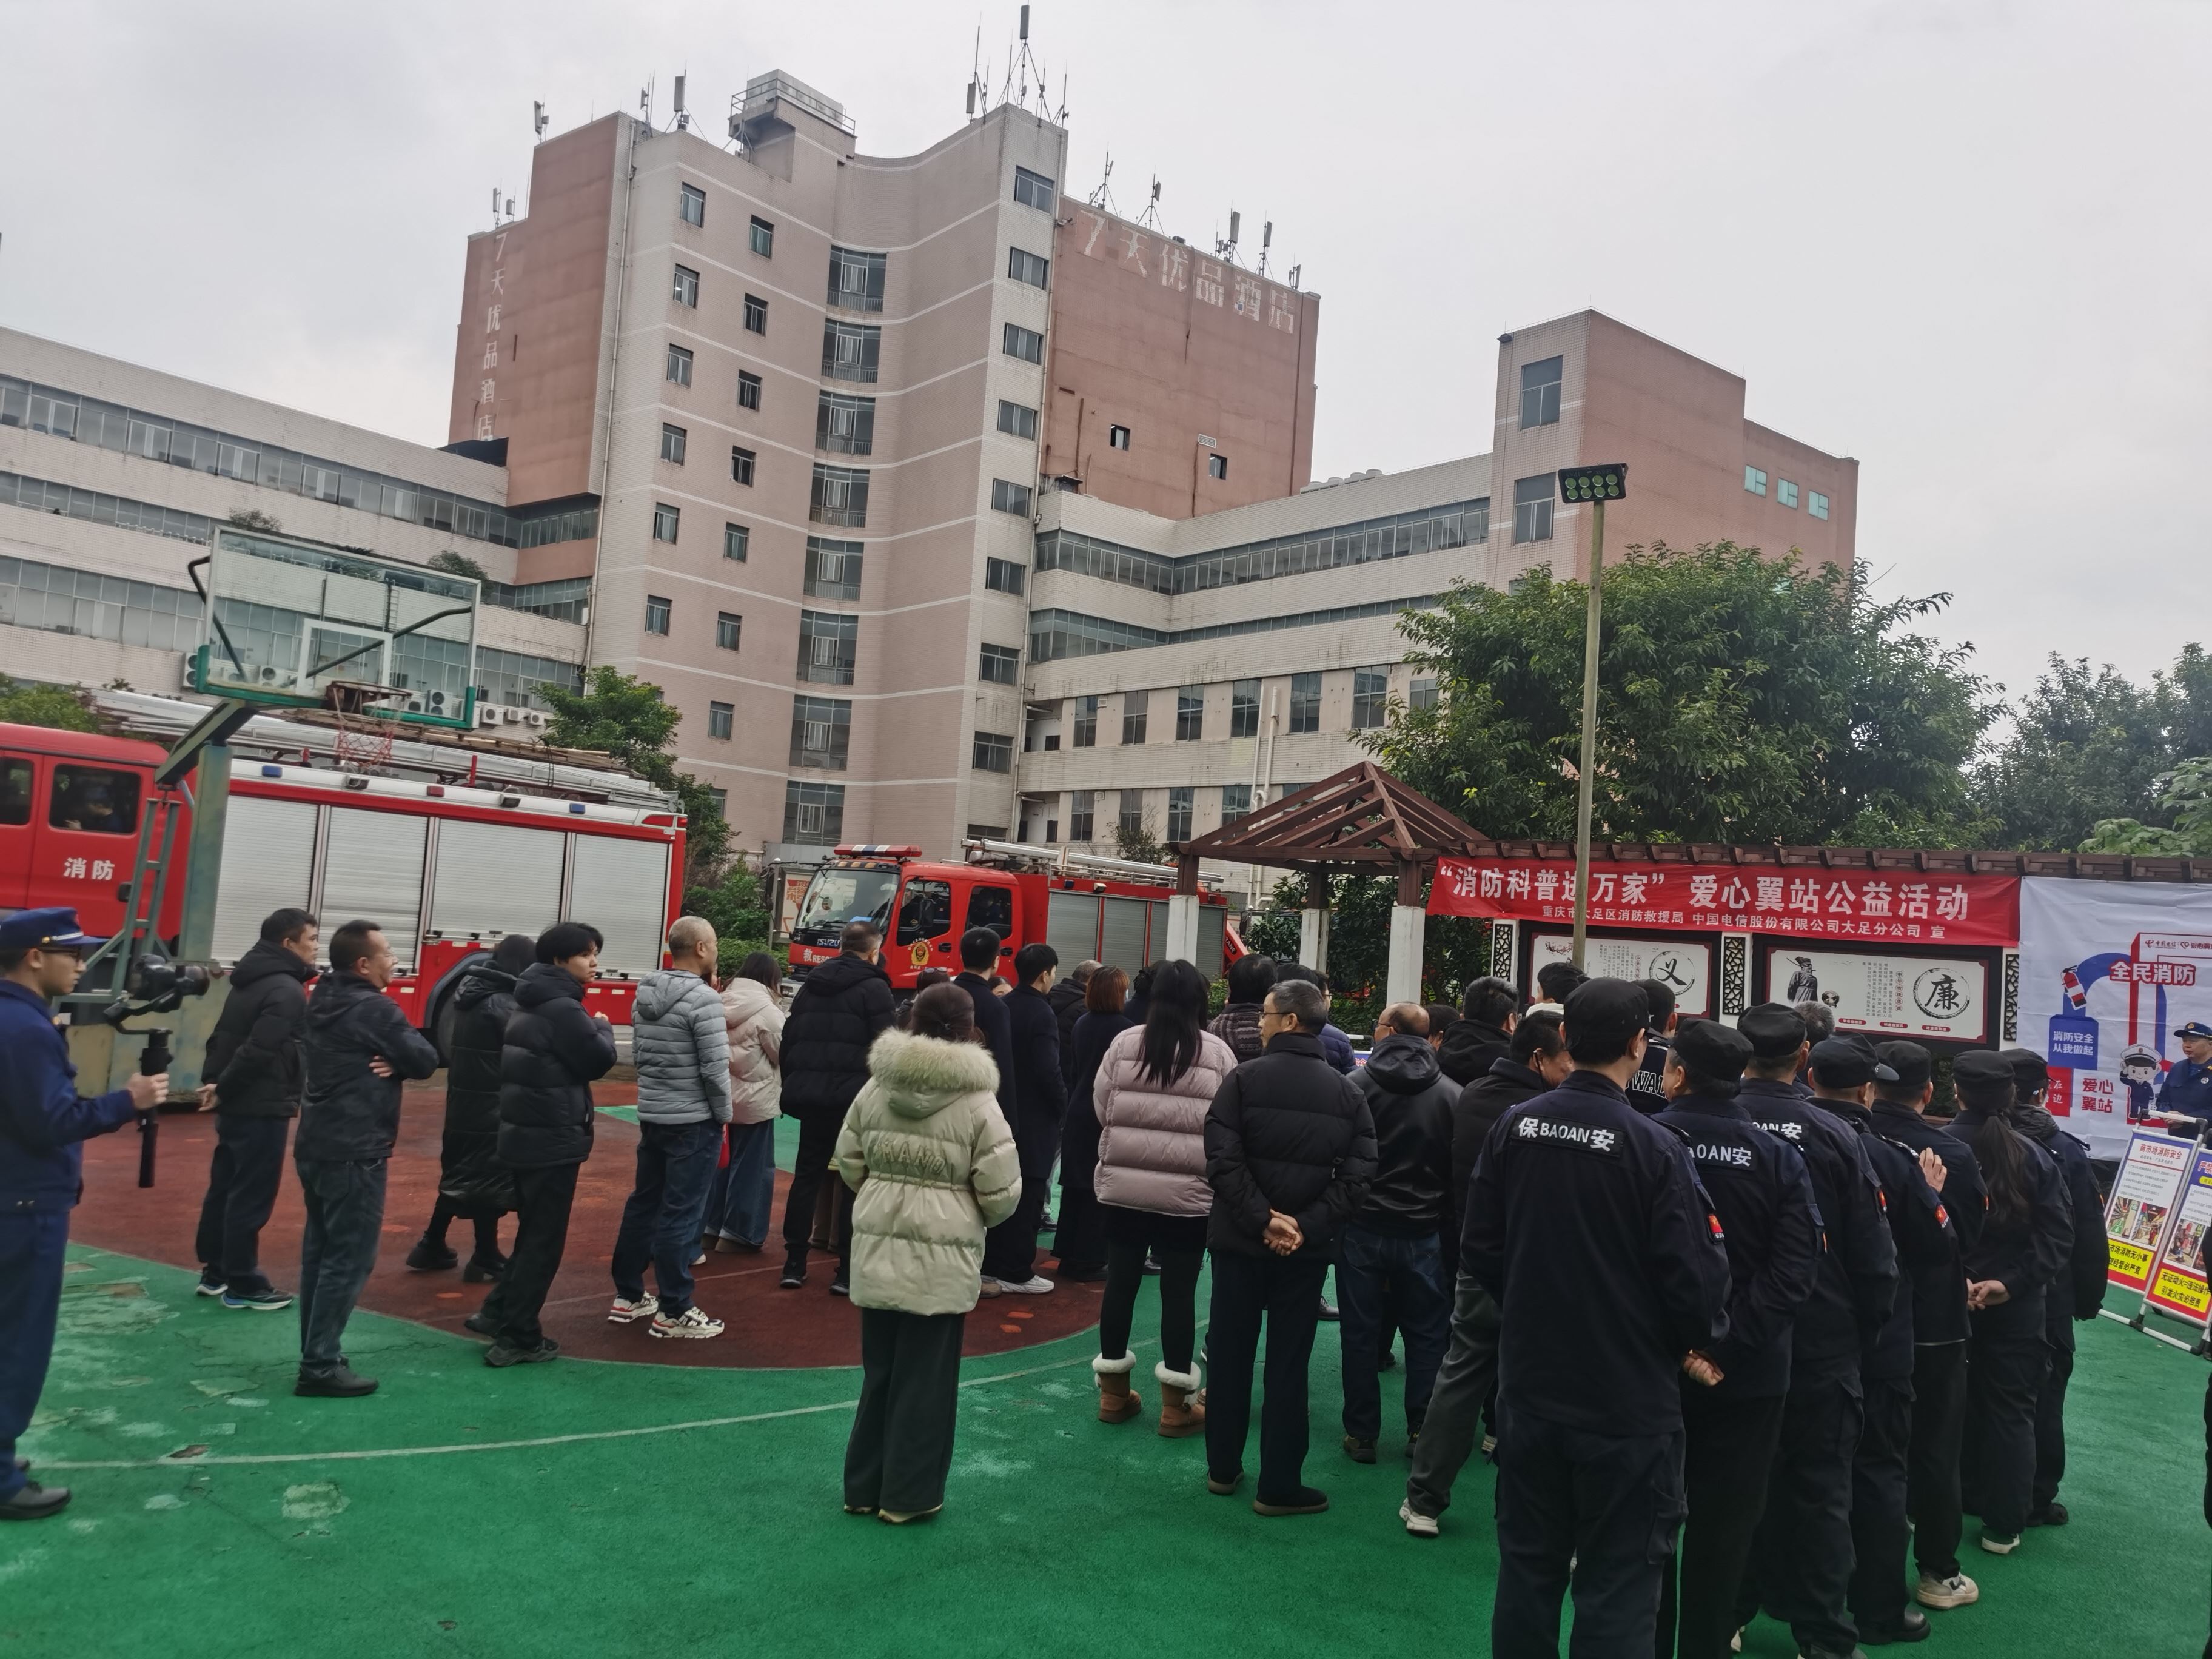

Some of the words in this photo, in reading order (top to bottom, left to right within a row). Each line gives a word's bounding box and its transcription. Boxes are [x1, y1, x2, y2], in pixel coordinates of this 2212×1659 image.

[63, 857, 115, 880] 消防
[1689, 874, 1968, 920] 爱心翼站公益活动
[1542, 905, 1683, 925] 重庆市足区消防救援局
[1692, 912, 1921, 937] 中国电信股份有限公司大足分公司
[1930, 925, 1945, 939] 宣
[817, 938, 840, 947] ISUZU
[803, 948, 813, 962] 救
[1655, 957, 1688, 986] 义
[2111, 962, 2195, 985] 全民消防
[1924, 973, 1960, 1011] 廉
[2053, 1031, 2094, 1044] 消防安全
[2053, 1043, 2094, 1056] 从我做起
[2082, 1078, 2114, 1094] 爱心
[2082, 1096, 2113, 1113] 翼站
[2139, 1144, 2183, 1160] 商市场消防安全
[2108, 1243, 2149, 1262] 市场消防无小事
